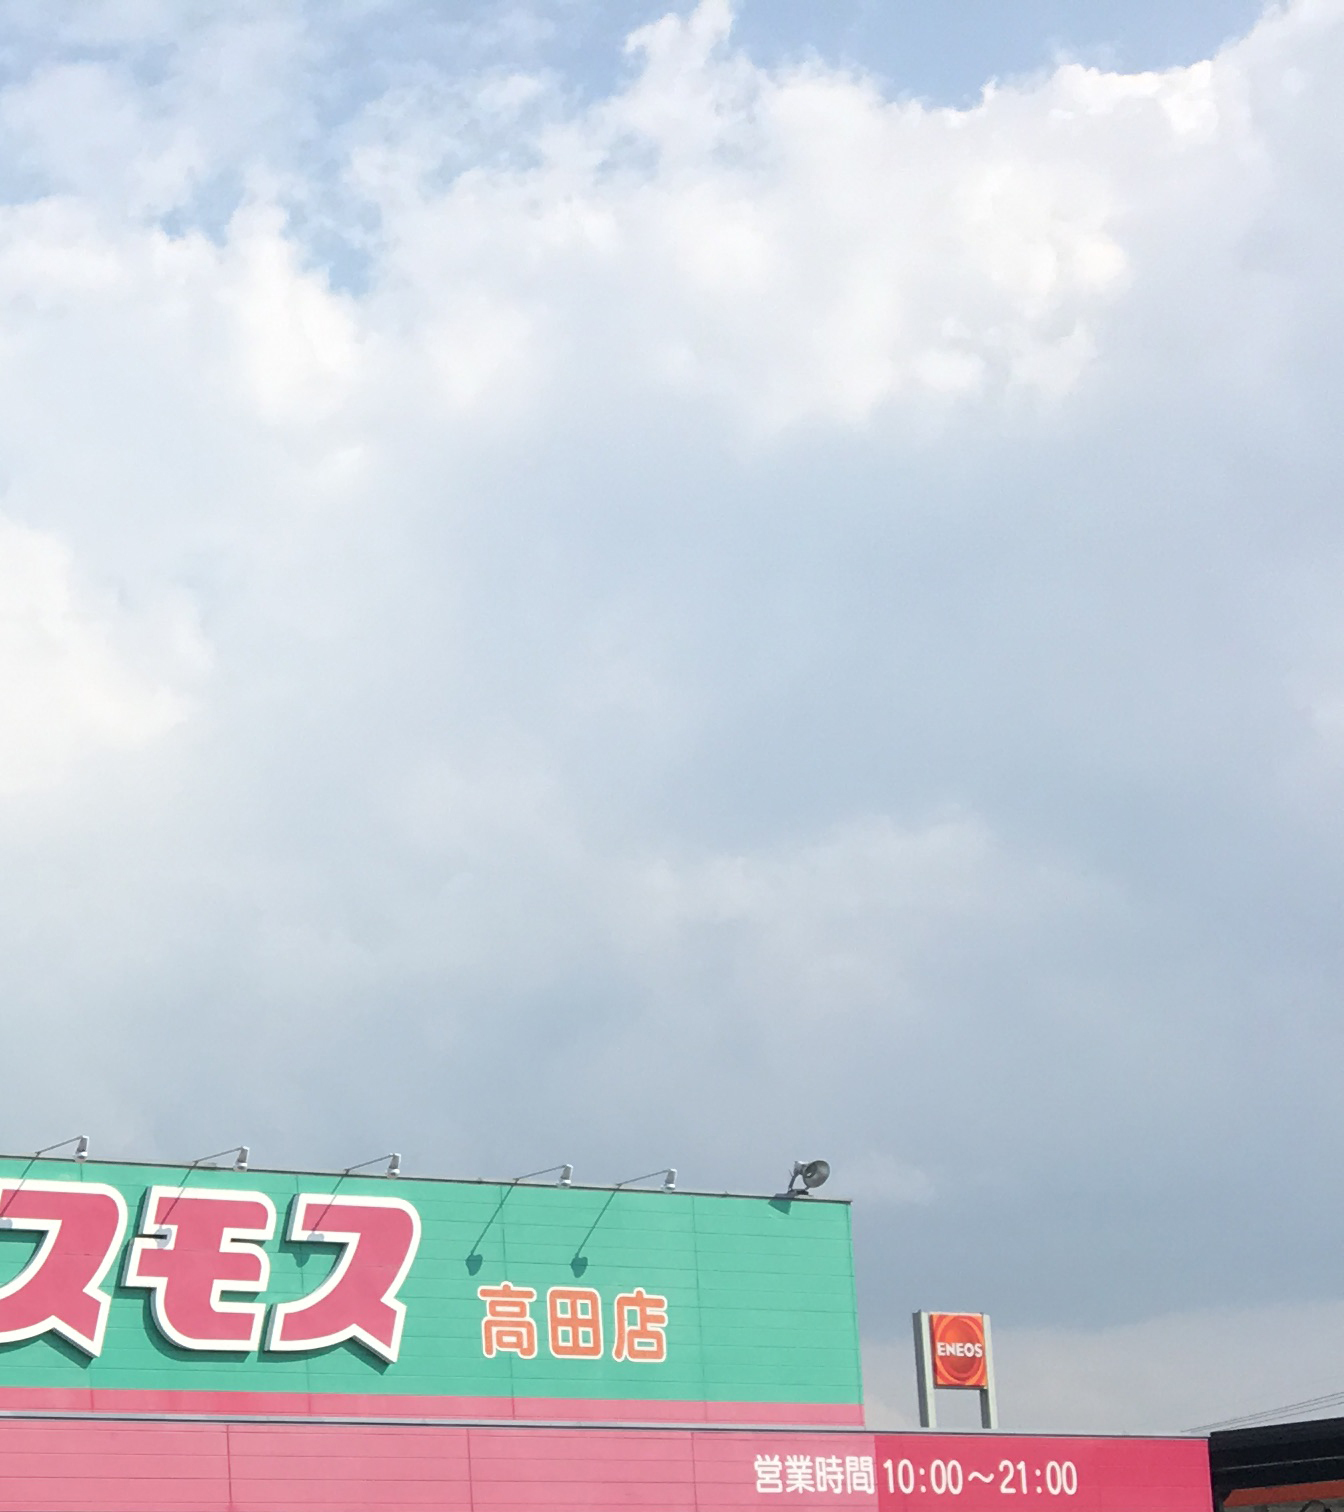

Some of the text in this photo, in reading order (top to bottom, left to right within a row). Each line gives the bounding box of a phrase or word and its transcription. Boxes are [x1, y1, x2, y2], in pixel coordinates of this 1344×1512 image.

[477, 1281, 668, 1362] 高田店
[936, 1341, 983, 1358] ENEOS
[754, 1454, 875, 1495] 営業時間
